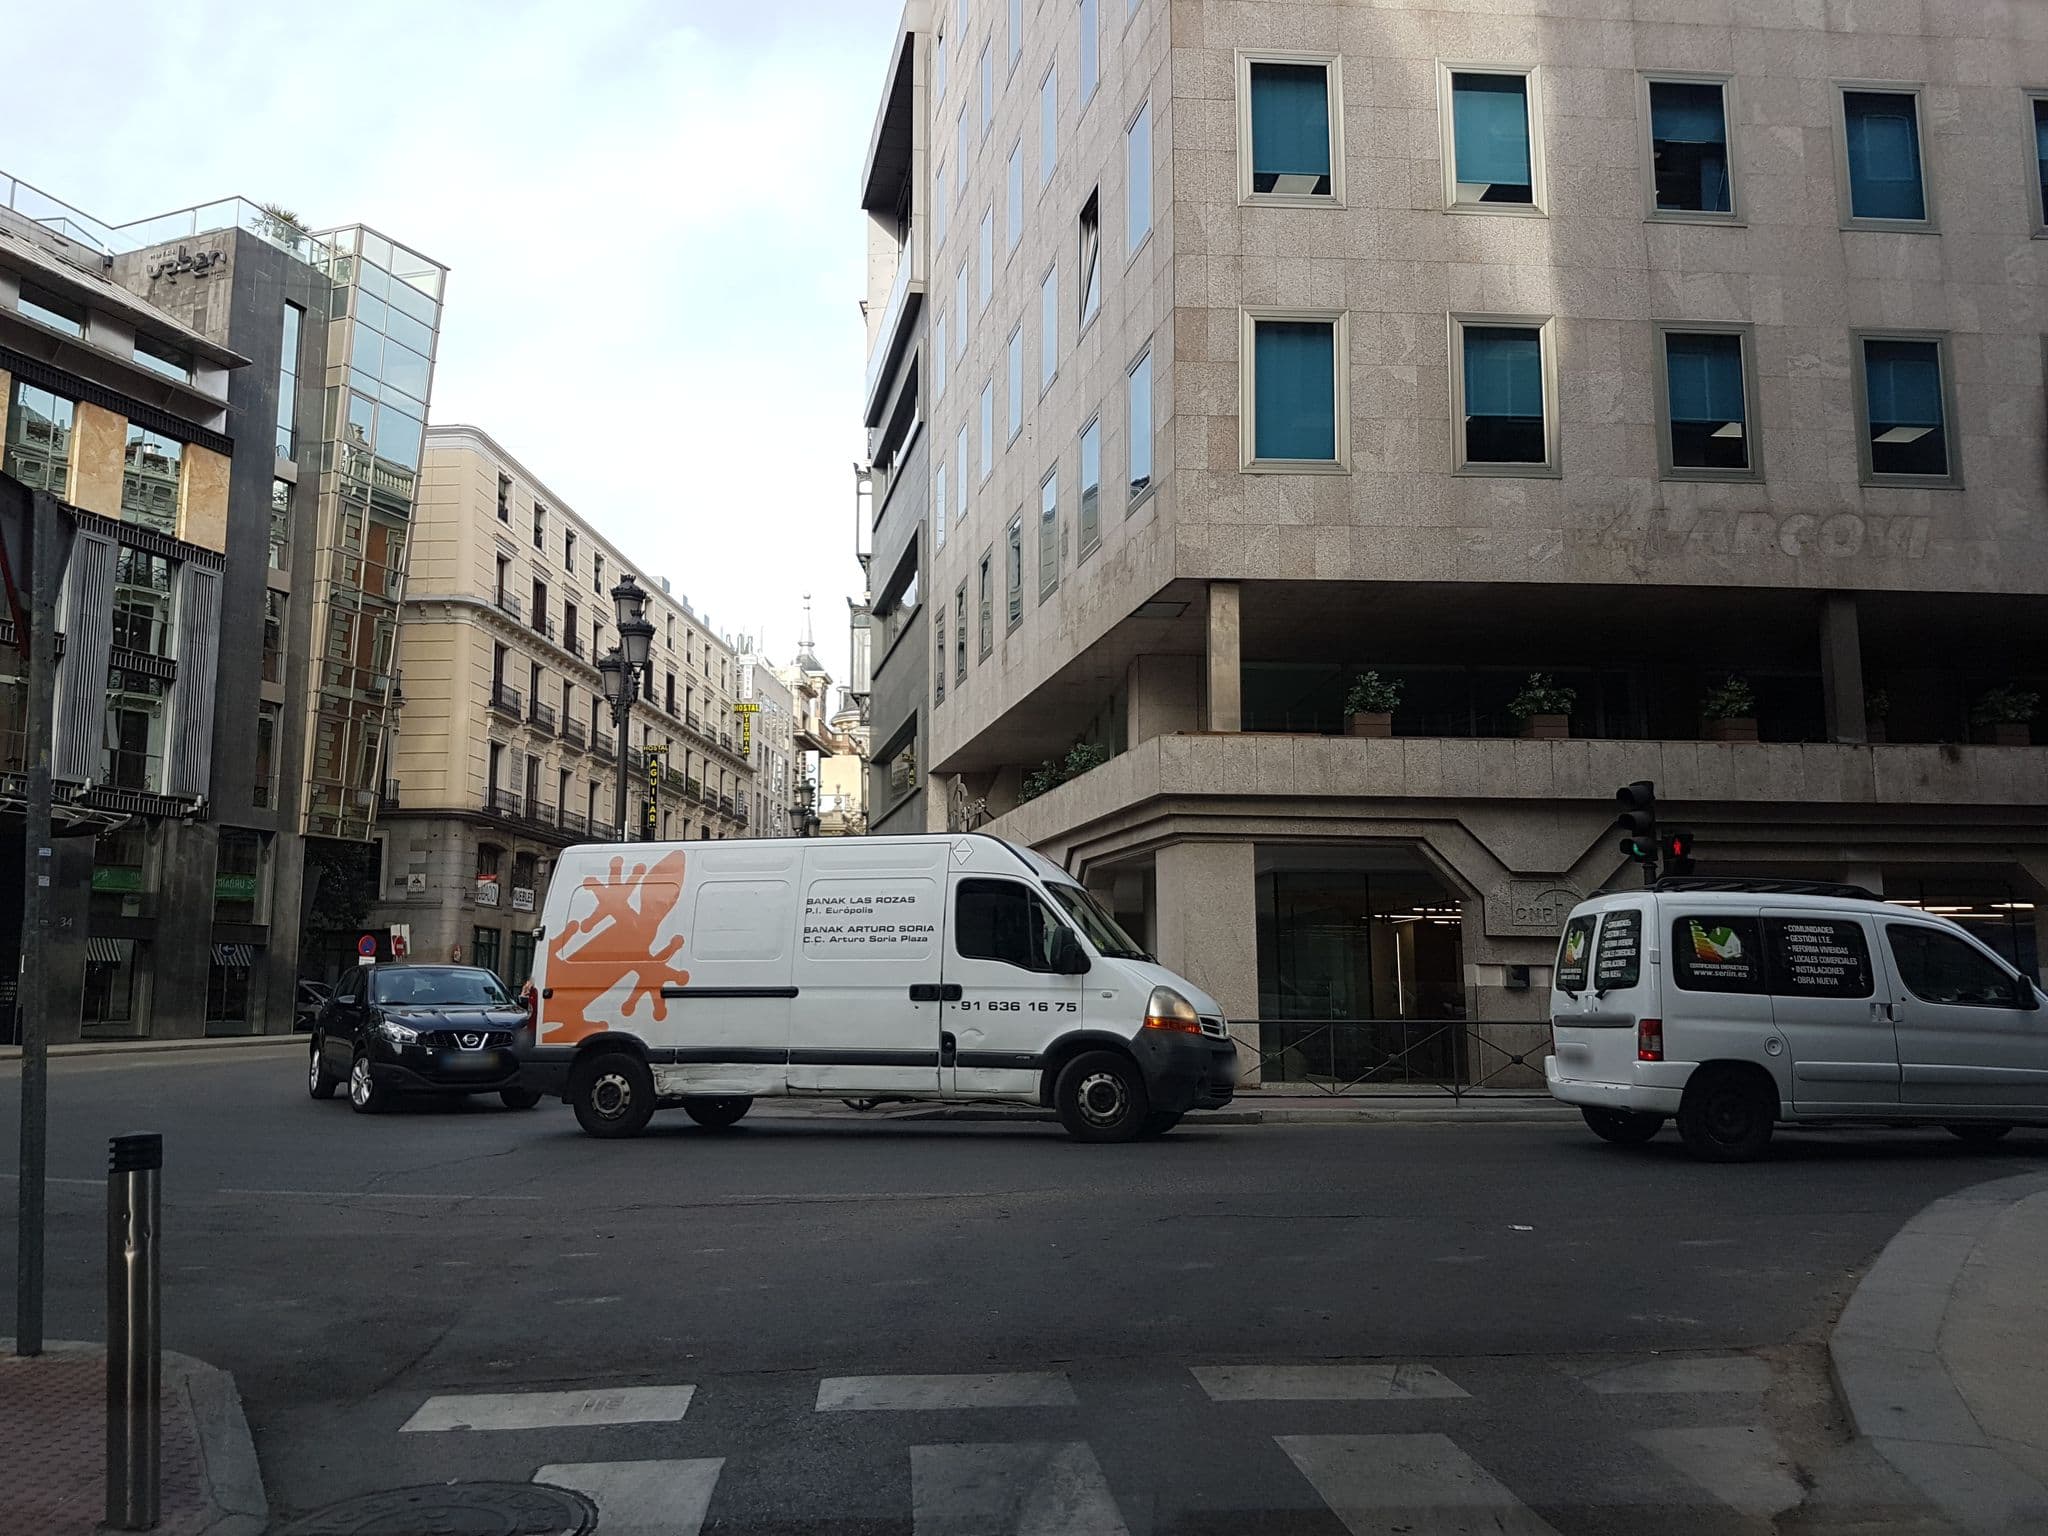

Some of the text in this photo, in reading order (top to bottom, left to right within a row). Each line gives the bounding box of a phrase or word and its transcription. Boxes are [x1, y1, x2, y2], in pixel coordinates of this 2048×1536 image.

[734, 703, 760, 712] HOSTAL
[649, 760, 657, 822] AGUILAR
[806, 897, 846, 905] BANAK
[876, 896, 916, 904] ROZAS
[825, 906, 873, 915] Európolis
[847, 925, 895, 933] ARTURO
[898, 925, 935, 933] SORIA
[1788, 925, 1834, 934] COMUNIDADES
[803, 934, 928, 943] C.C. Arturo Soria Plaza
[1797, 976, 1839, 985] OBRA NUEVA
[961, 1001, 1077, 1012] 91 636 16 75
